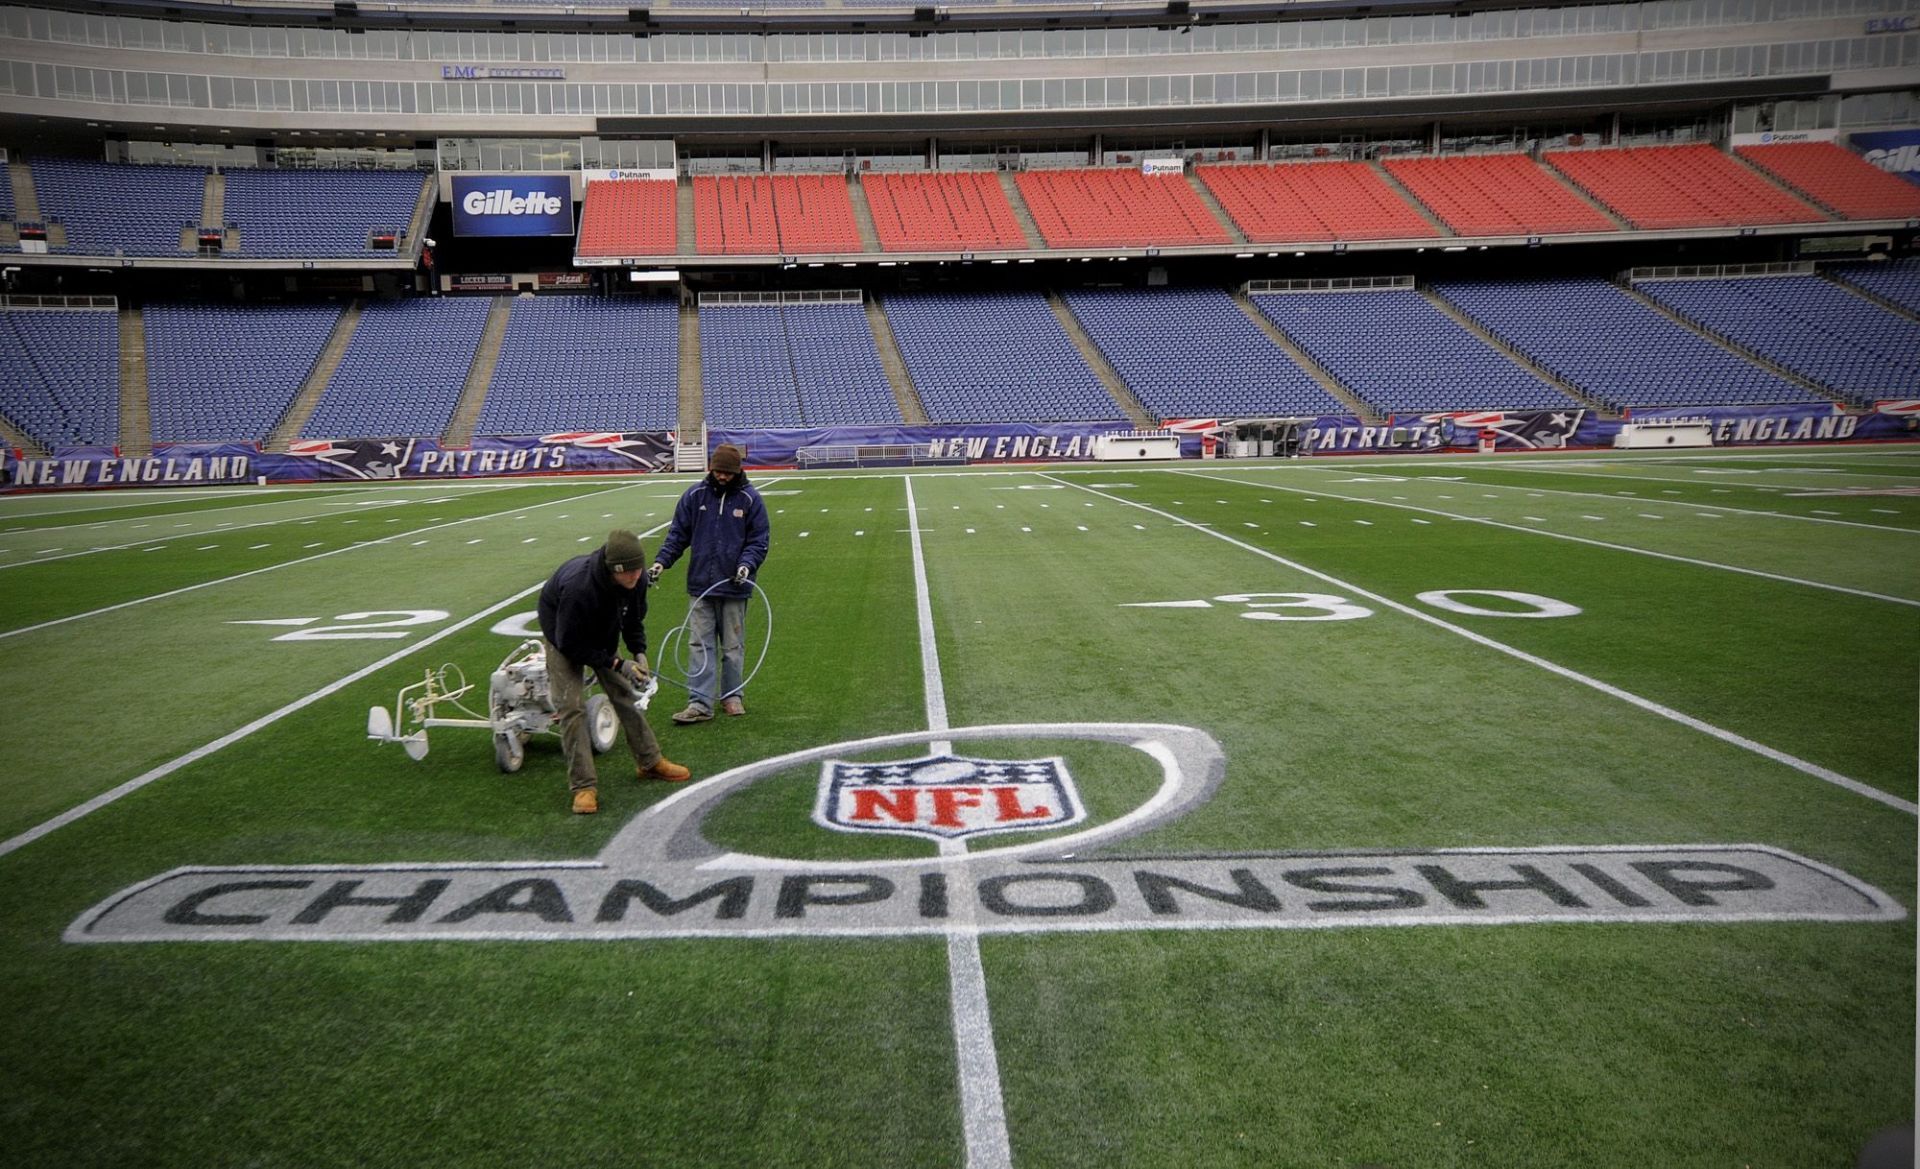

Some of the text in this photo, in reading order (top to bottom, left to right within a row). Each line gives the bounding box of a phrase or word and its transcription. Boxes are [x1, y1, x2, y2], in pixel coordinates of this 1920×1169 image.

[1773, 133, 1809, 141] Putnam
[619, 171, 651, 179] Putnam
[1152, 164, 1181, 172] Putnam
[463, 190, 562, 215] Gillette
[555, 274, 582, 285] pizza
[1716, 415, 1858, 441] ENGLAND
[420, 446, 566, 473] PATRIOTS
[928, 435, 1104, 459] NEW ENGLAN
[14, 456, 250, 486] NEW ENGLAND
[848, 787, 1052, 828] NFL
[163, 859, 1776, 926] CHAMPIONSHIP
